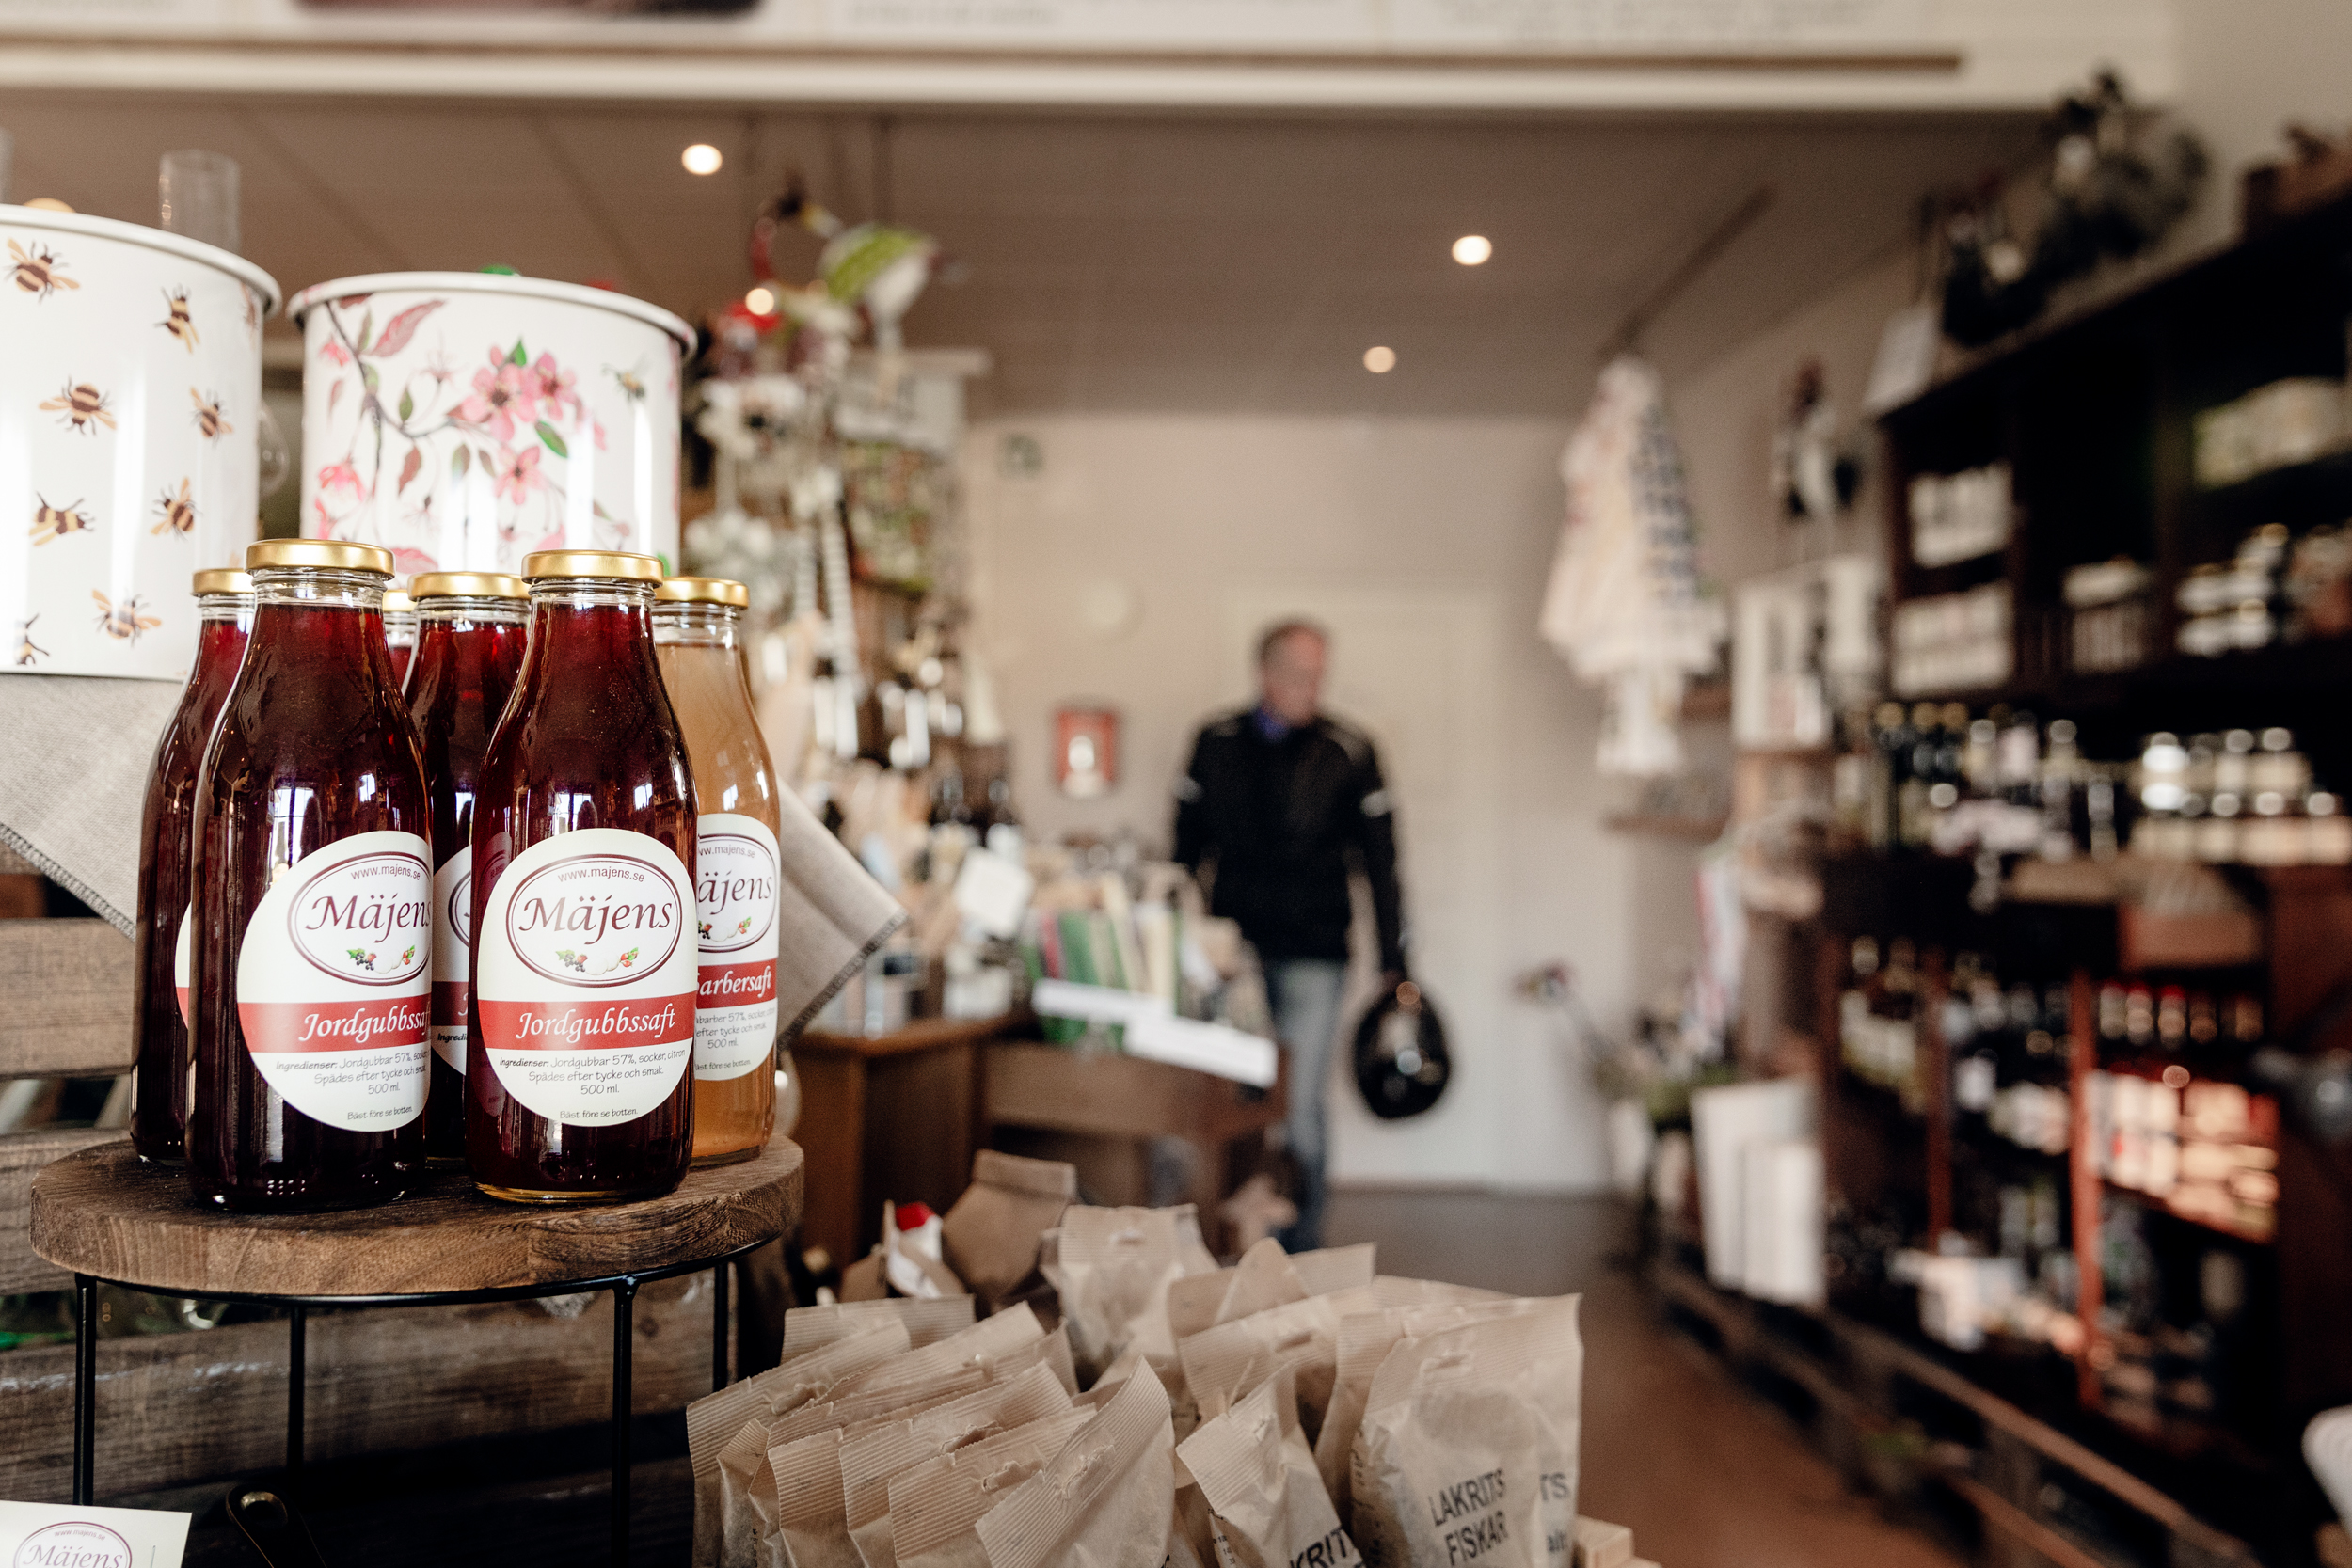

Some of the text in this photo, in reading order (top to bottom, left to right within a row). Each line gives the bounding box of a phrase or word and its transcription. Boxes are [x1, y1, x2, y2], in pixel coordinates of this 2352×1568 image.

[351, 864, 421, 880] www.majens.se
[558, 866, 644, 883] www.majens.se
[698, 870, 772, 915] äjens
[305, 893, 431, 943] Mäjens
[518, 895, 673, 945] Mäjens
[516, 1003, 675, 1044] Jordgubbssaft
[707, 1038, 727, 1050] 500
[340, 1055, 393, 1070] Jordgubbar
[550, 1056, 611, 1069] Jordgubbar
[314, 1073, 354, 1087] Spädes
[356, 1069, 380, 1081] efter
[382, 1067, 403, 1081] tycke
[529, 1070, 565, 1085] Spädes
[567, 1069, 594, 1081] efter
[596, 1069, 622, 1083] tycke
[624, 1069, 640, 1079] och
[368, 1083, 389, 1095] 500
[580, 1083, 620, 1095] 500 ml.
[347, 1111, 368, 1120] Bäst
[370, 1108, 384, 1118] före
[560, 1110, 580, 1119] Bäst
[582, 1109, 599, 1118] före
[1428, 1467, 1505, 1528] LAKRITS
[55, 1528, 106, 1541] www.majens.se
[1444, 1510, 1509, 1567] FISKAR
